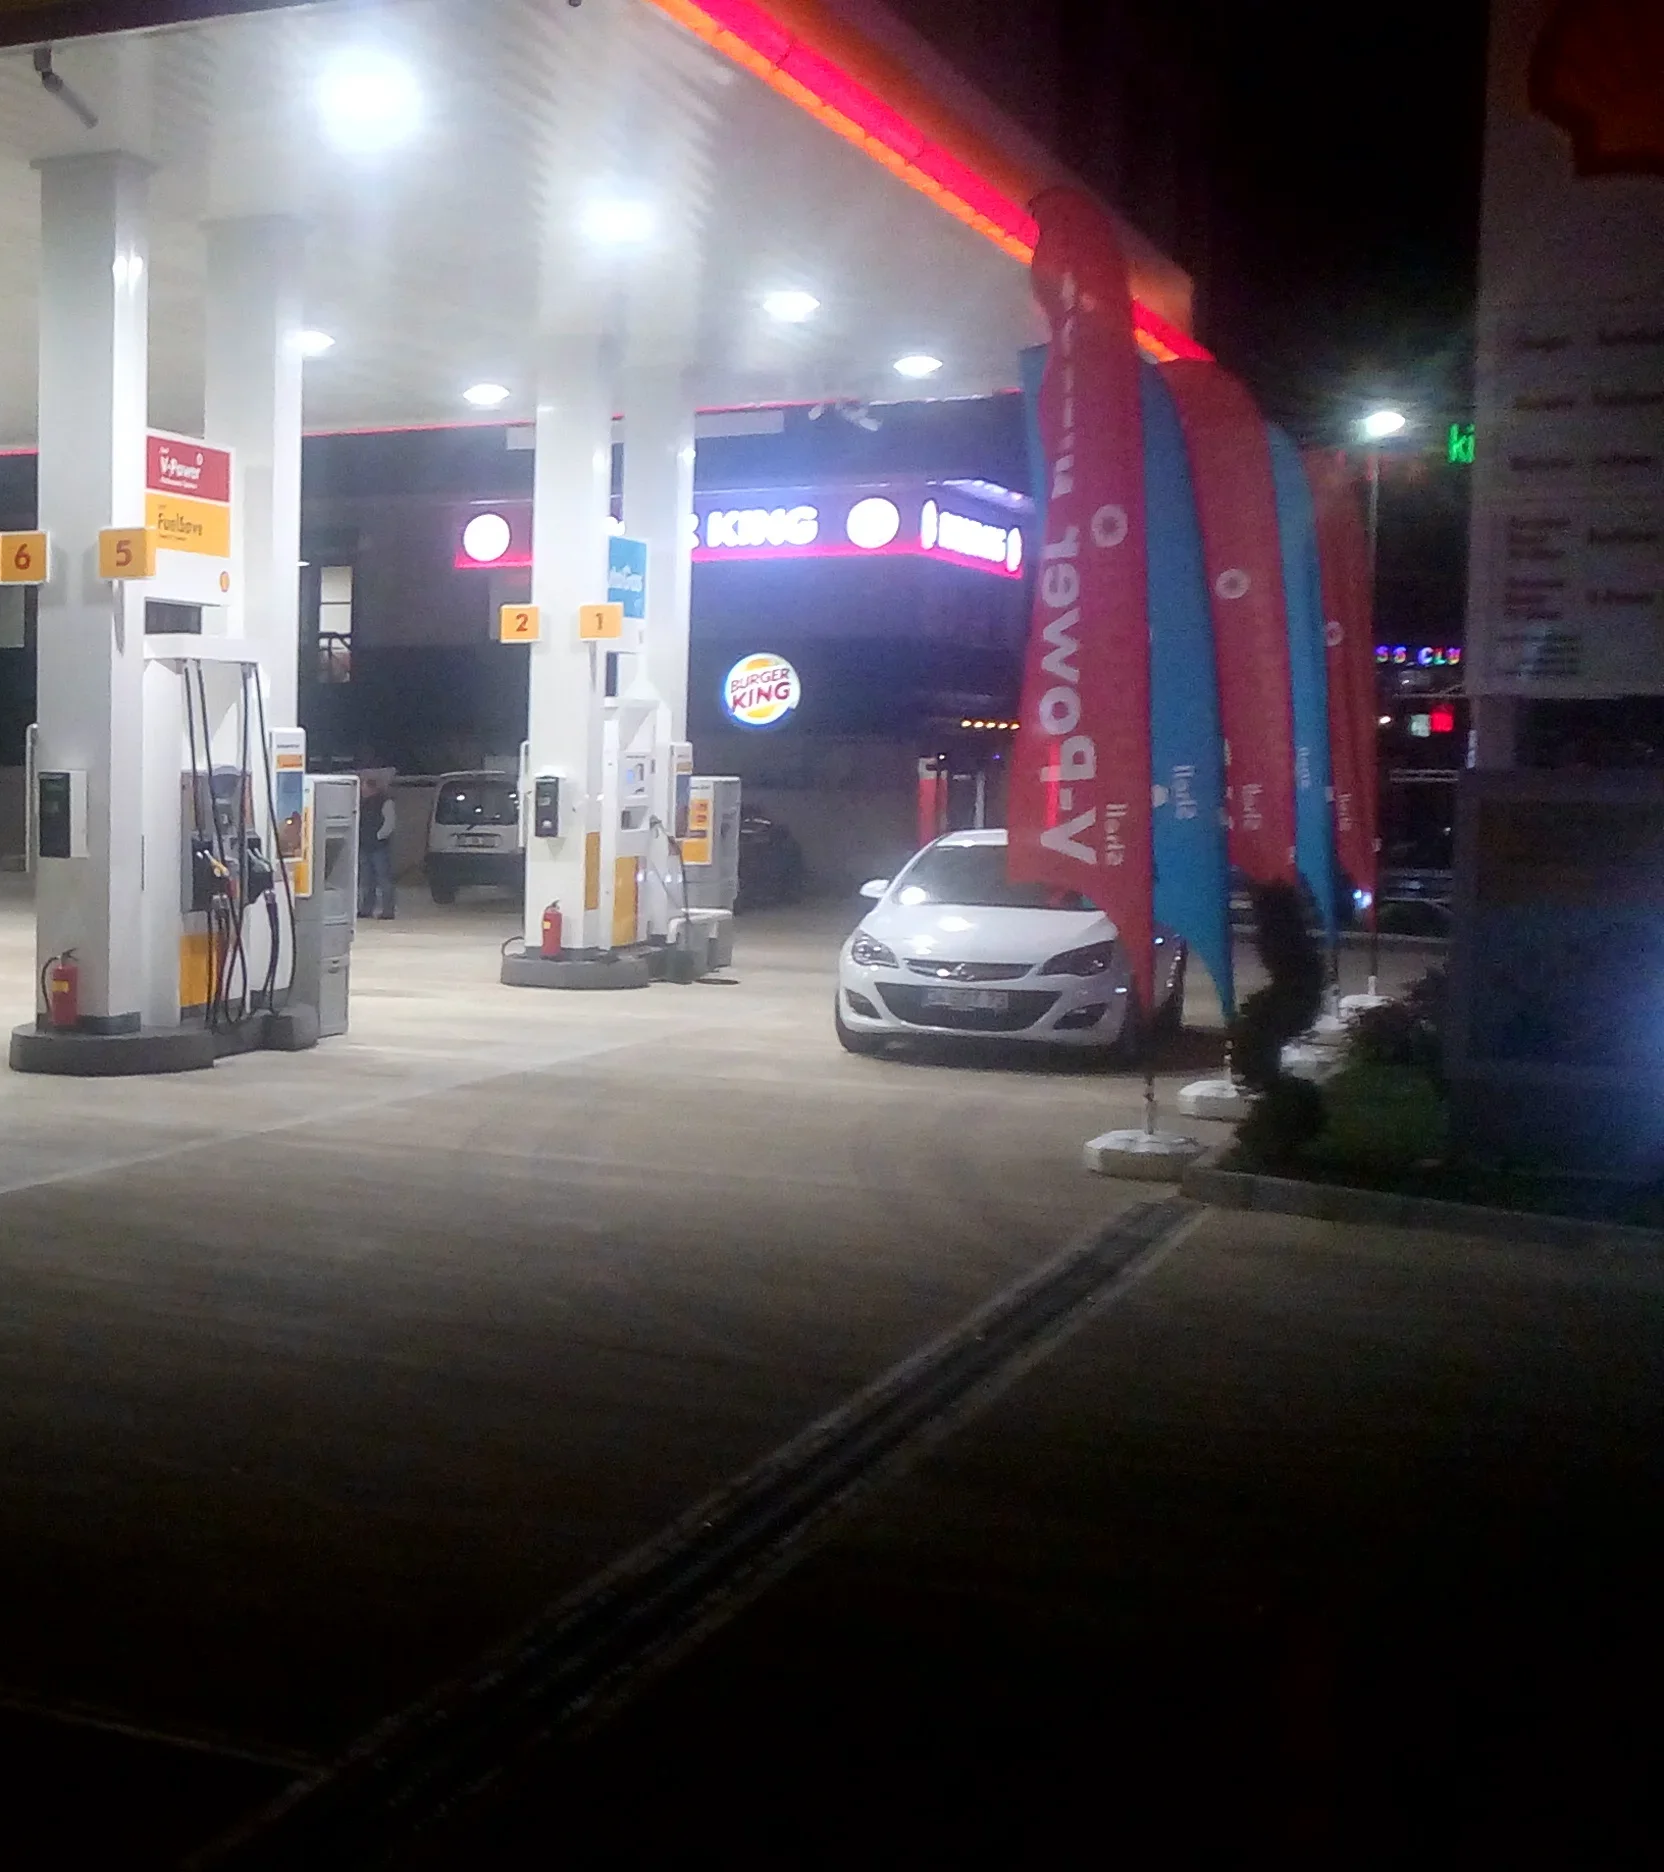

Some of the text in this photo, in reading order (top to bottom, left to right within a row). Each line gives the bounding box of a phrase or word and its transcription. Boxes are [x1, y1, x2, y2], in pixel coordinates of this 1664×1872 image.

[706, 505, 819, 548] KING
[14, 543, 31, 570] 6
[116, 539, 133, 566] 5
[516, 613, 529, 632] 2
[595, 612, 604, 631] 1
[731, 667, 790, 694] BURGER
[732, 681, 791, 713] KING
